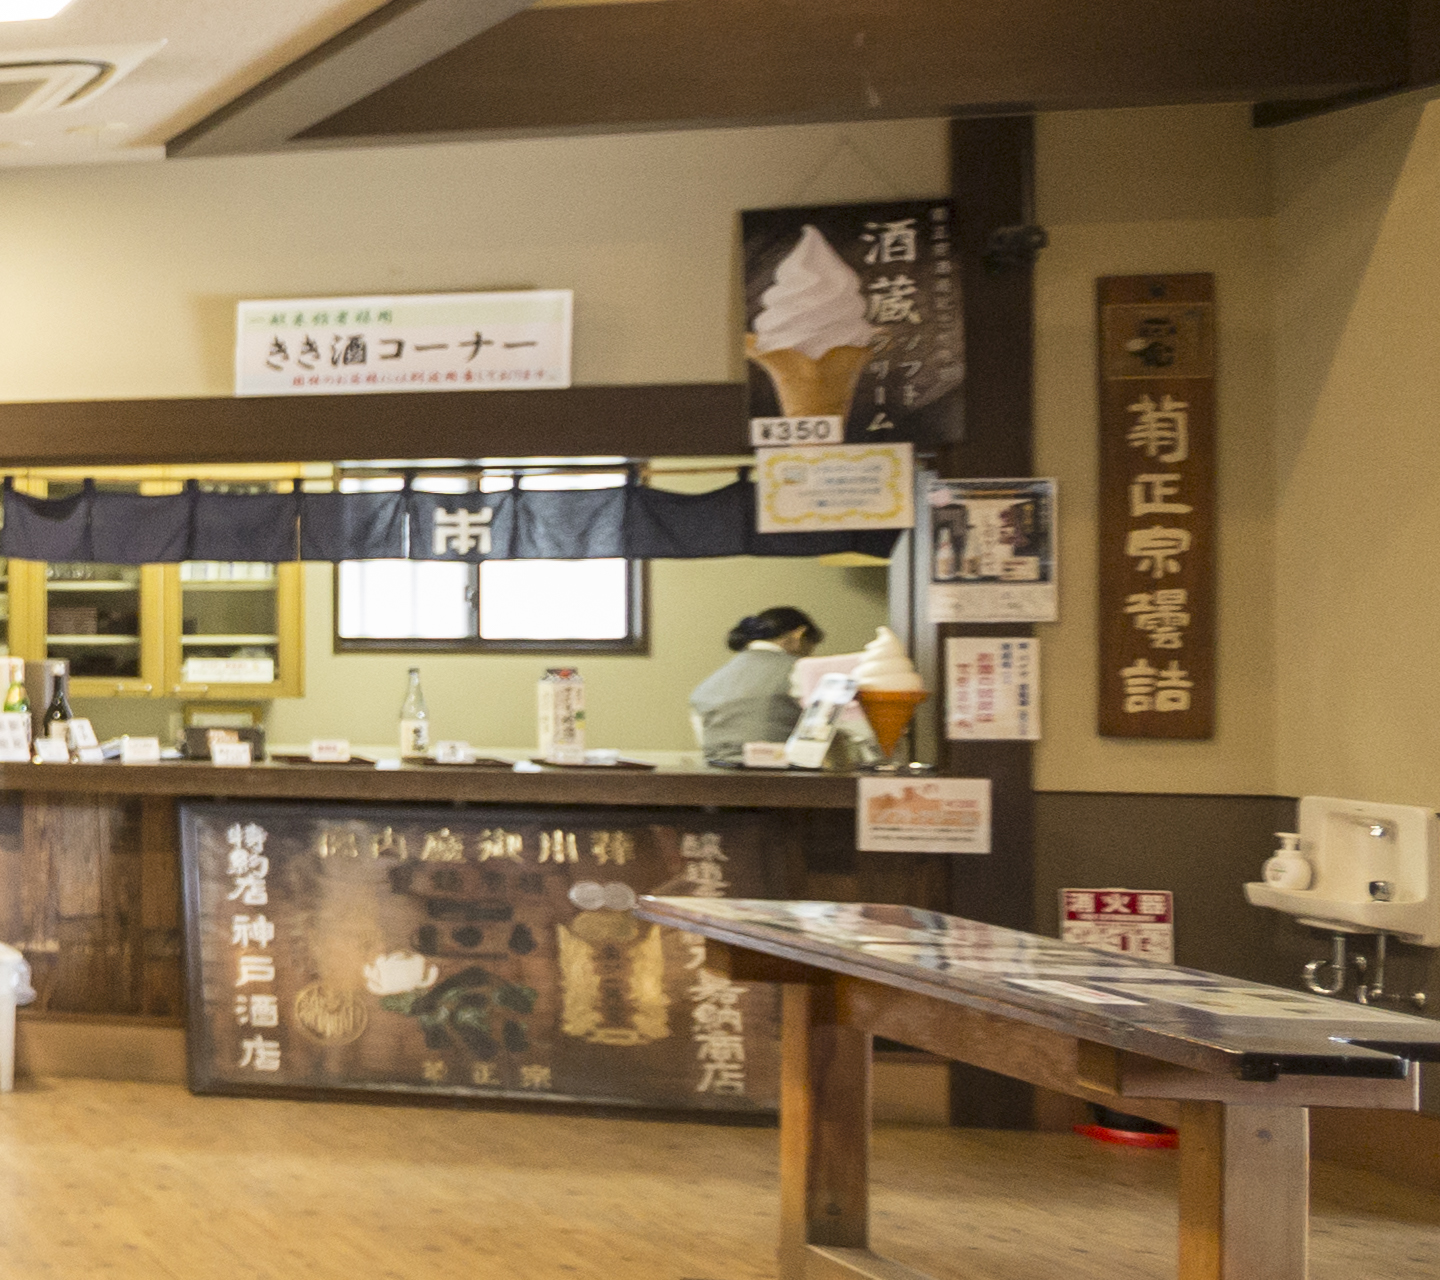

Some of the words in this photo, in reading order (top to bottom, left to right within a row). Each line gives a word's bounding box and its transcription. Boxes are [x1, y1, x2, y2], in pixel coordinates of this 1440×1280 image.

[860, 219, 922, 324] 酒蔵
[266, 332, 537, 370] きき酒コーナー
[761, 420, 830, 440] ¥350
[1066, 892, 1169, 915] 消火器
[232, 914, 281, 1072] 神戸酒店
